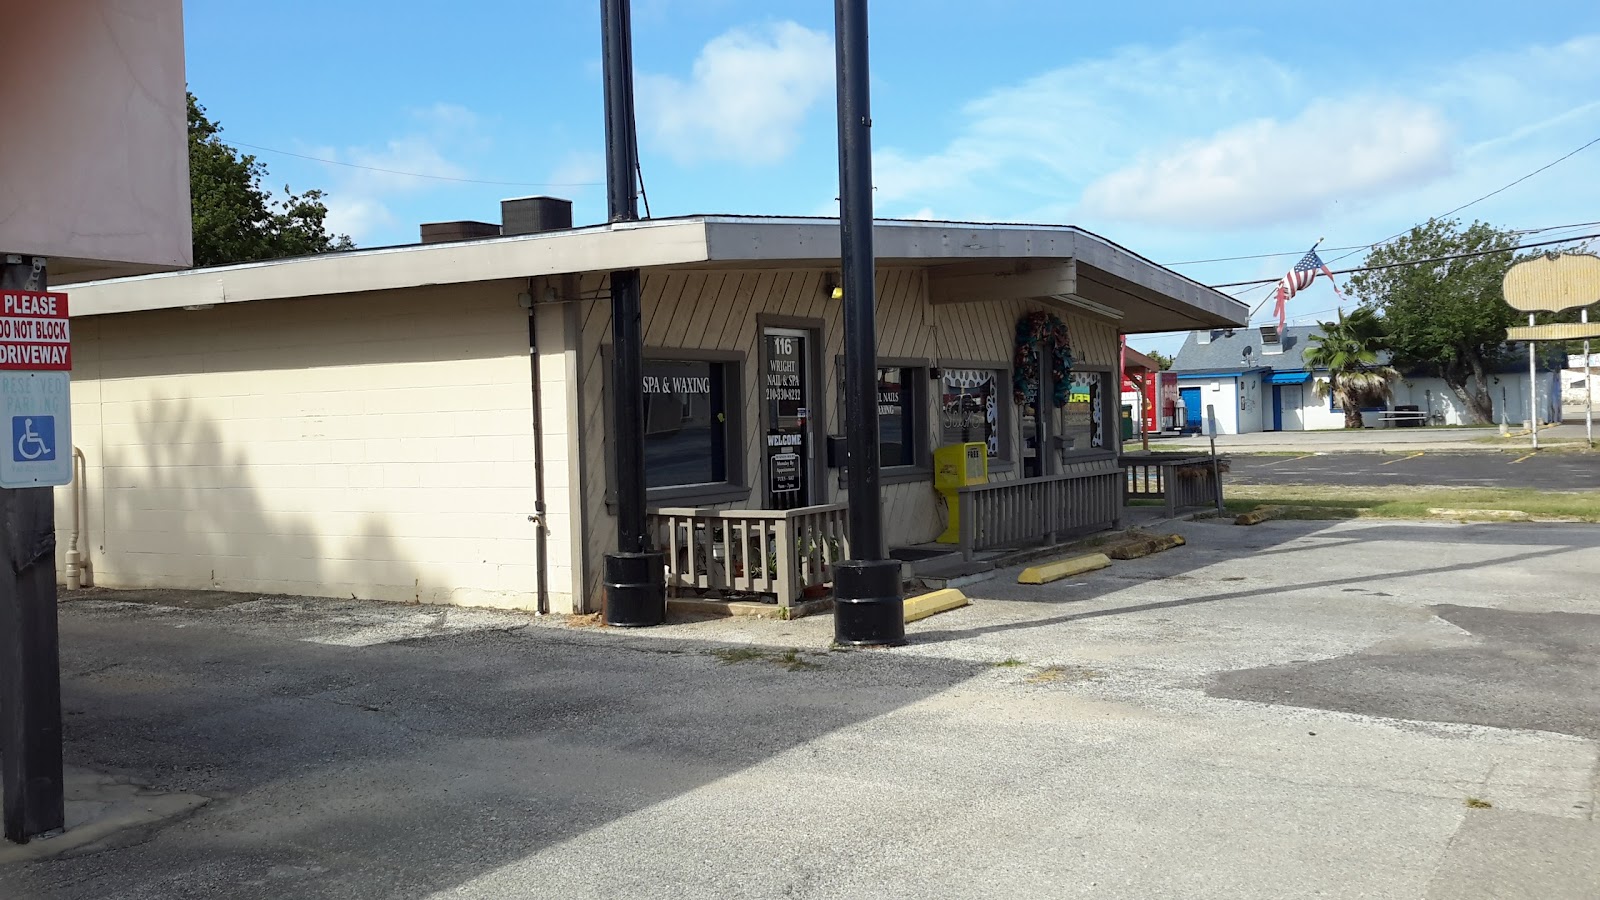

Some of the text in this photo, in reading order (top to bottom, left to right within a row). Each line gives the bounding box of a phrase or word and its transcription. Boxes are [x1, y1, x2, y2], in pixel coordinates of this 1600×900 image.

[4, 294, 57, 315] PLEASE
[0, 319, 67, 340] DO NOT BLOCK
[775, 337, 792, 355] 116
[0, 345, 68, 364] DRIVEWAY
[770, 360, 795, 372] WRIGHT
[3, 378, 62, 394] RESEVED
[642, 376, 710, 393] SPA & WAXING
[767, 374, 799, 386] NAIL & SPA
[7, 397, 59, 412] PARING
[883, 392, 899, 402] NAILS
[767, 434, 802, 446] WELCOME
